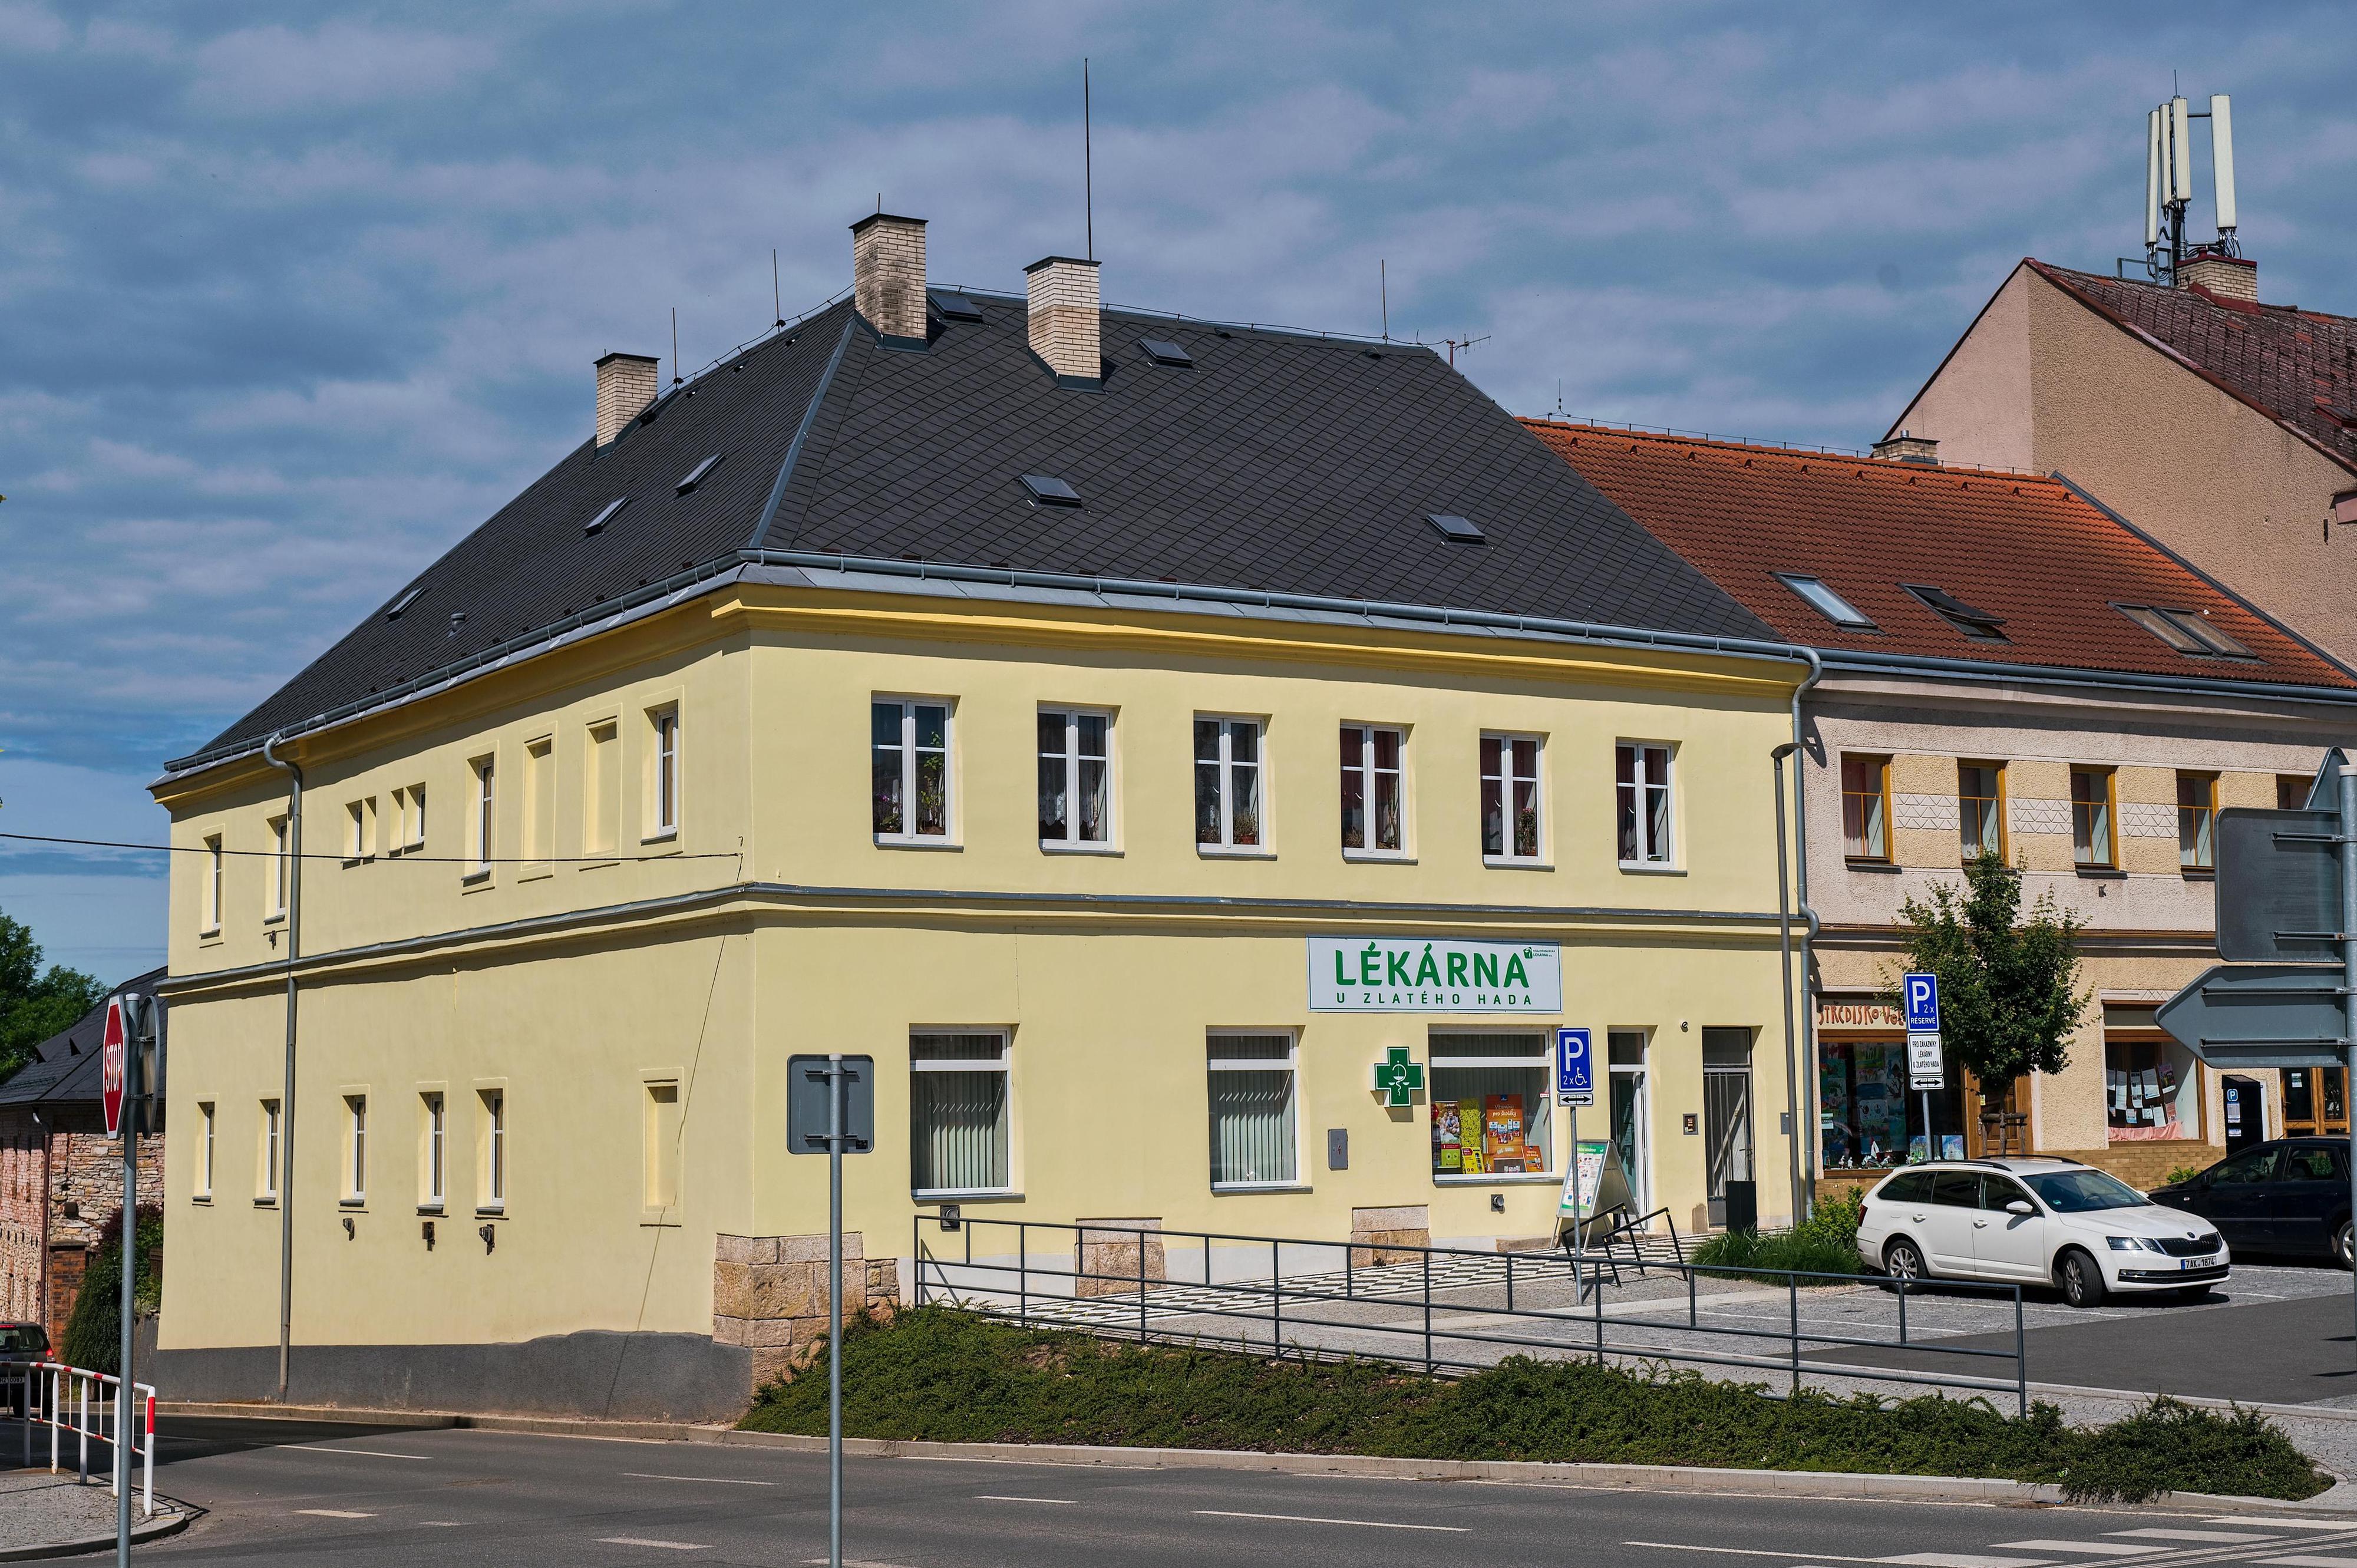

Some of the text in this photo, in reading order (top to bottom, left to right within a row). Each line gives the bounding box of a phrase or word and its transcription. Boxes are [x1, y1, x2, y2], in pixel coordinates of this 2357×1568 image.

[1335, 942, 1530, 988] LÉKÁRNA
[1336, 991, 1531, 1005] U ZLATÉHO HADA
[1912, 981, 1930, 1014] P
[1910, 1015, 1936, 1024] RÉSERVÉ
[1919, 1039, 1937, 1048] ZÁKAZNÍKY
[1564, 1037, 1584, 1071] P
[1918, 1049, 1933, 1058] LÉKÁRNY
[106, 1042, 122, 1094] STOP
[1916, 1059, 1930, 1068] ZLATÉHO
[2230, 1091, 2236, 1100] P
[2186, 1257, 2214, 1268] 7AK 1874
